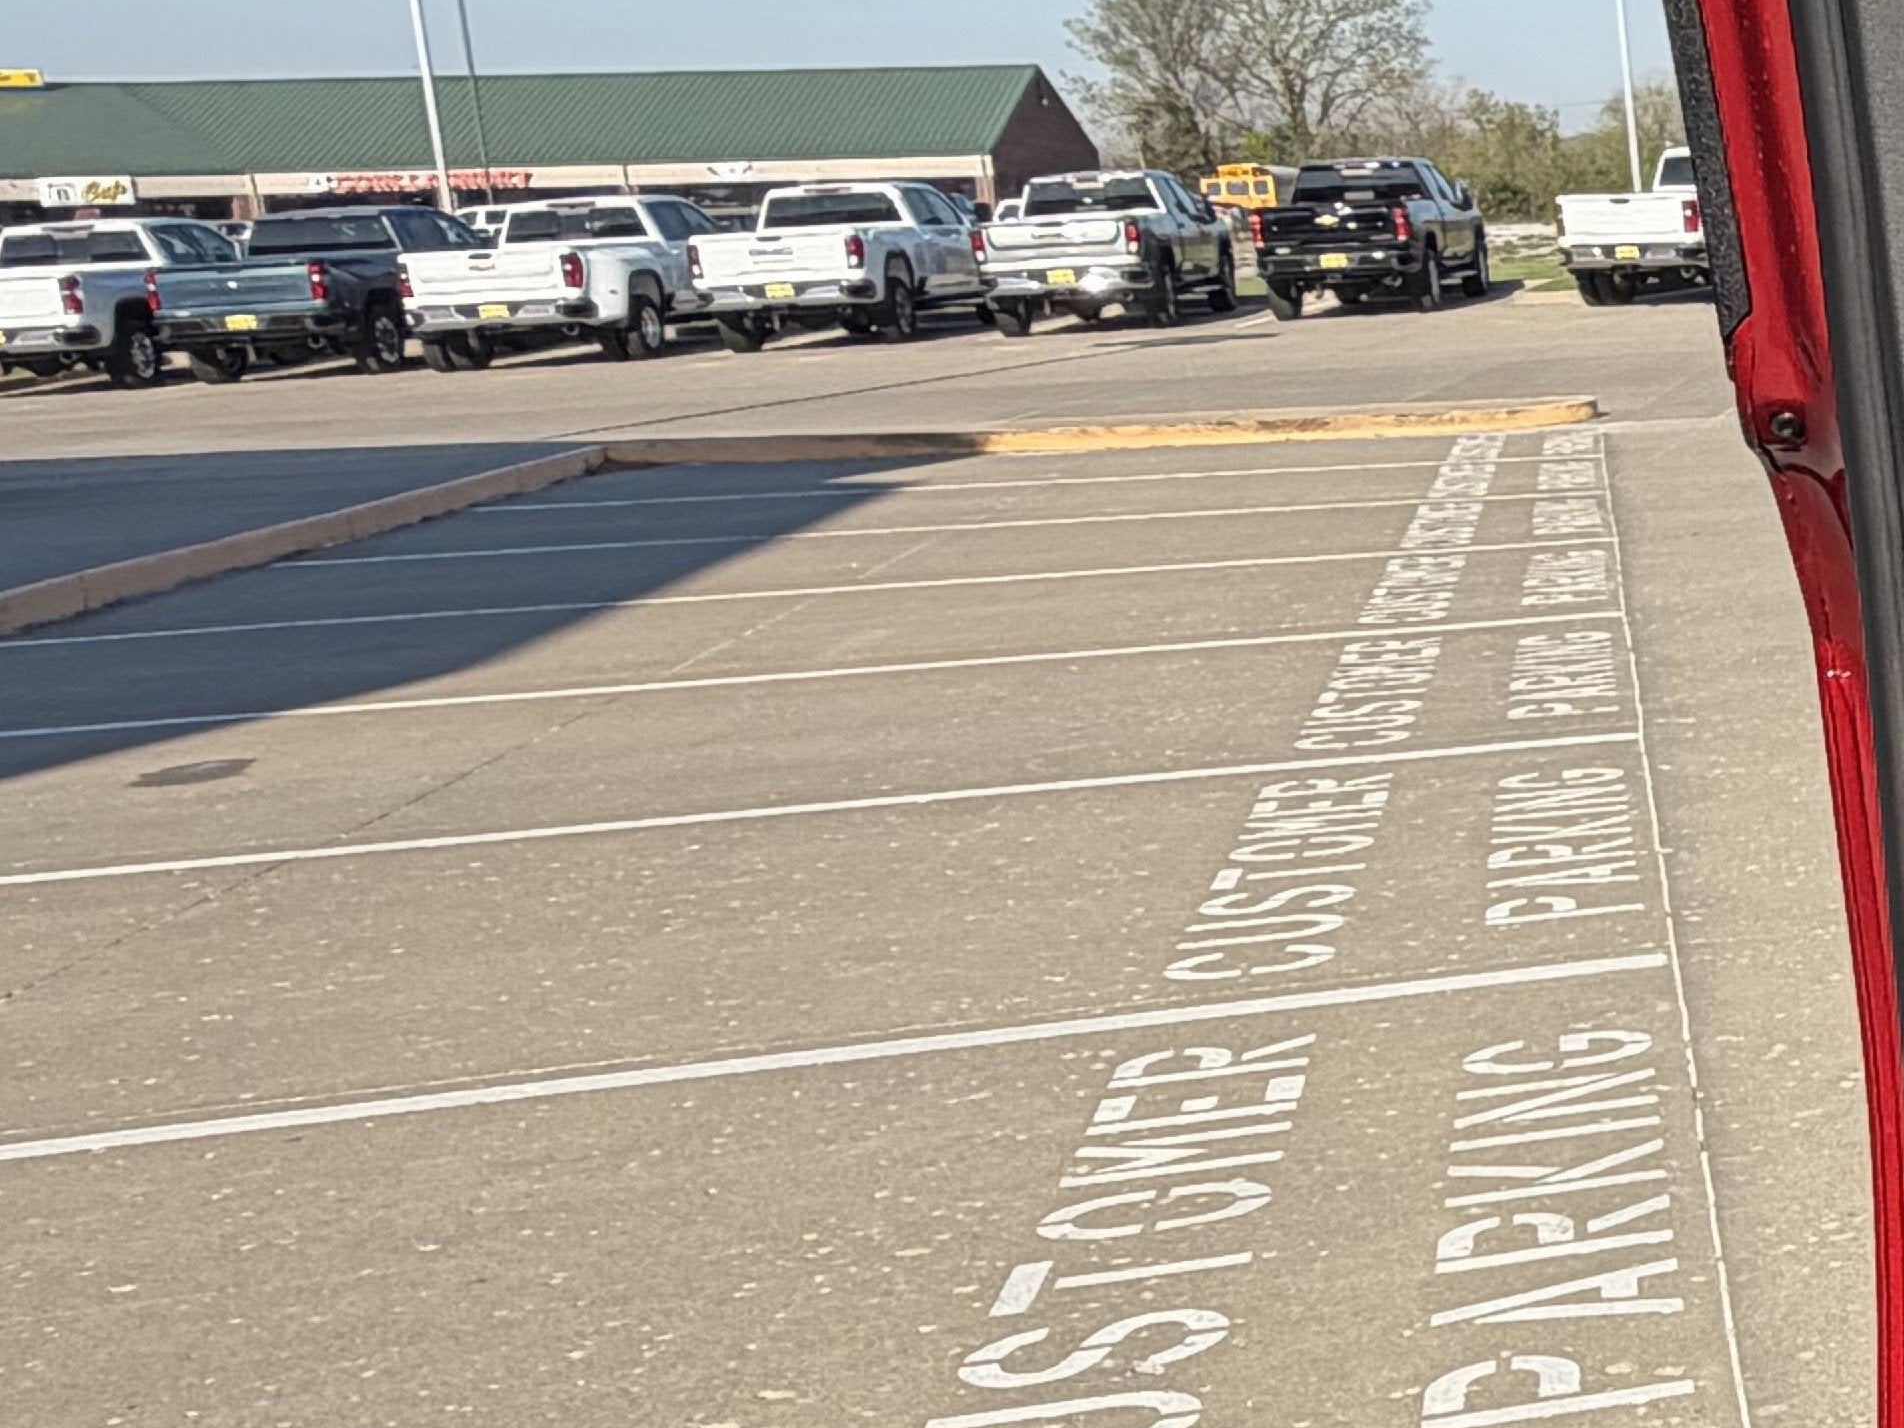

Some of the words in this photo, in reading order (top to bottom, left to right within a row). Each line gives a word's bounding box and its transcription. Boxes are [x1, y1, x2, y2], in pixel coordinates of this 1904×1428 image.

[1294, 636, 1442, 750] CUSTOMER
[1507, 630, 1620, 720] PARKING
[1164, 772, 1394, 980] CUSTOMER
[1485, 767, 1646, 927] PARKING
